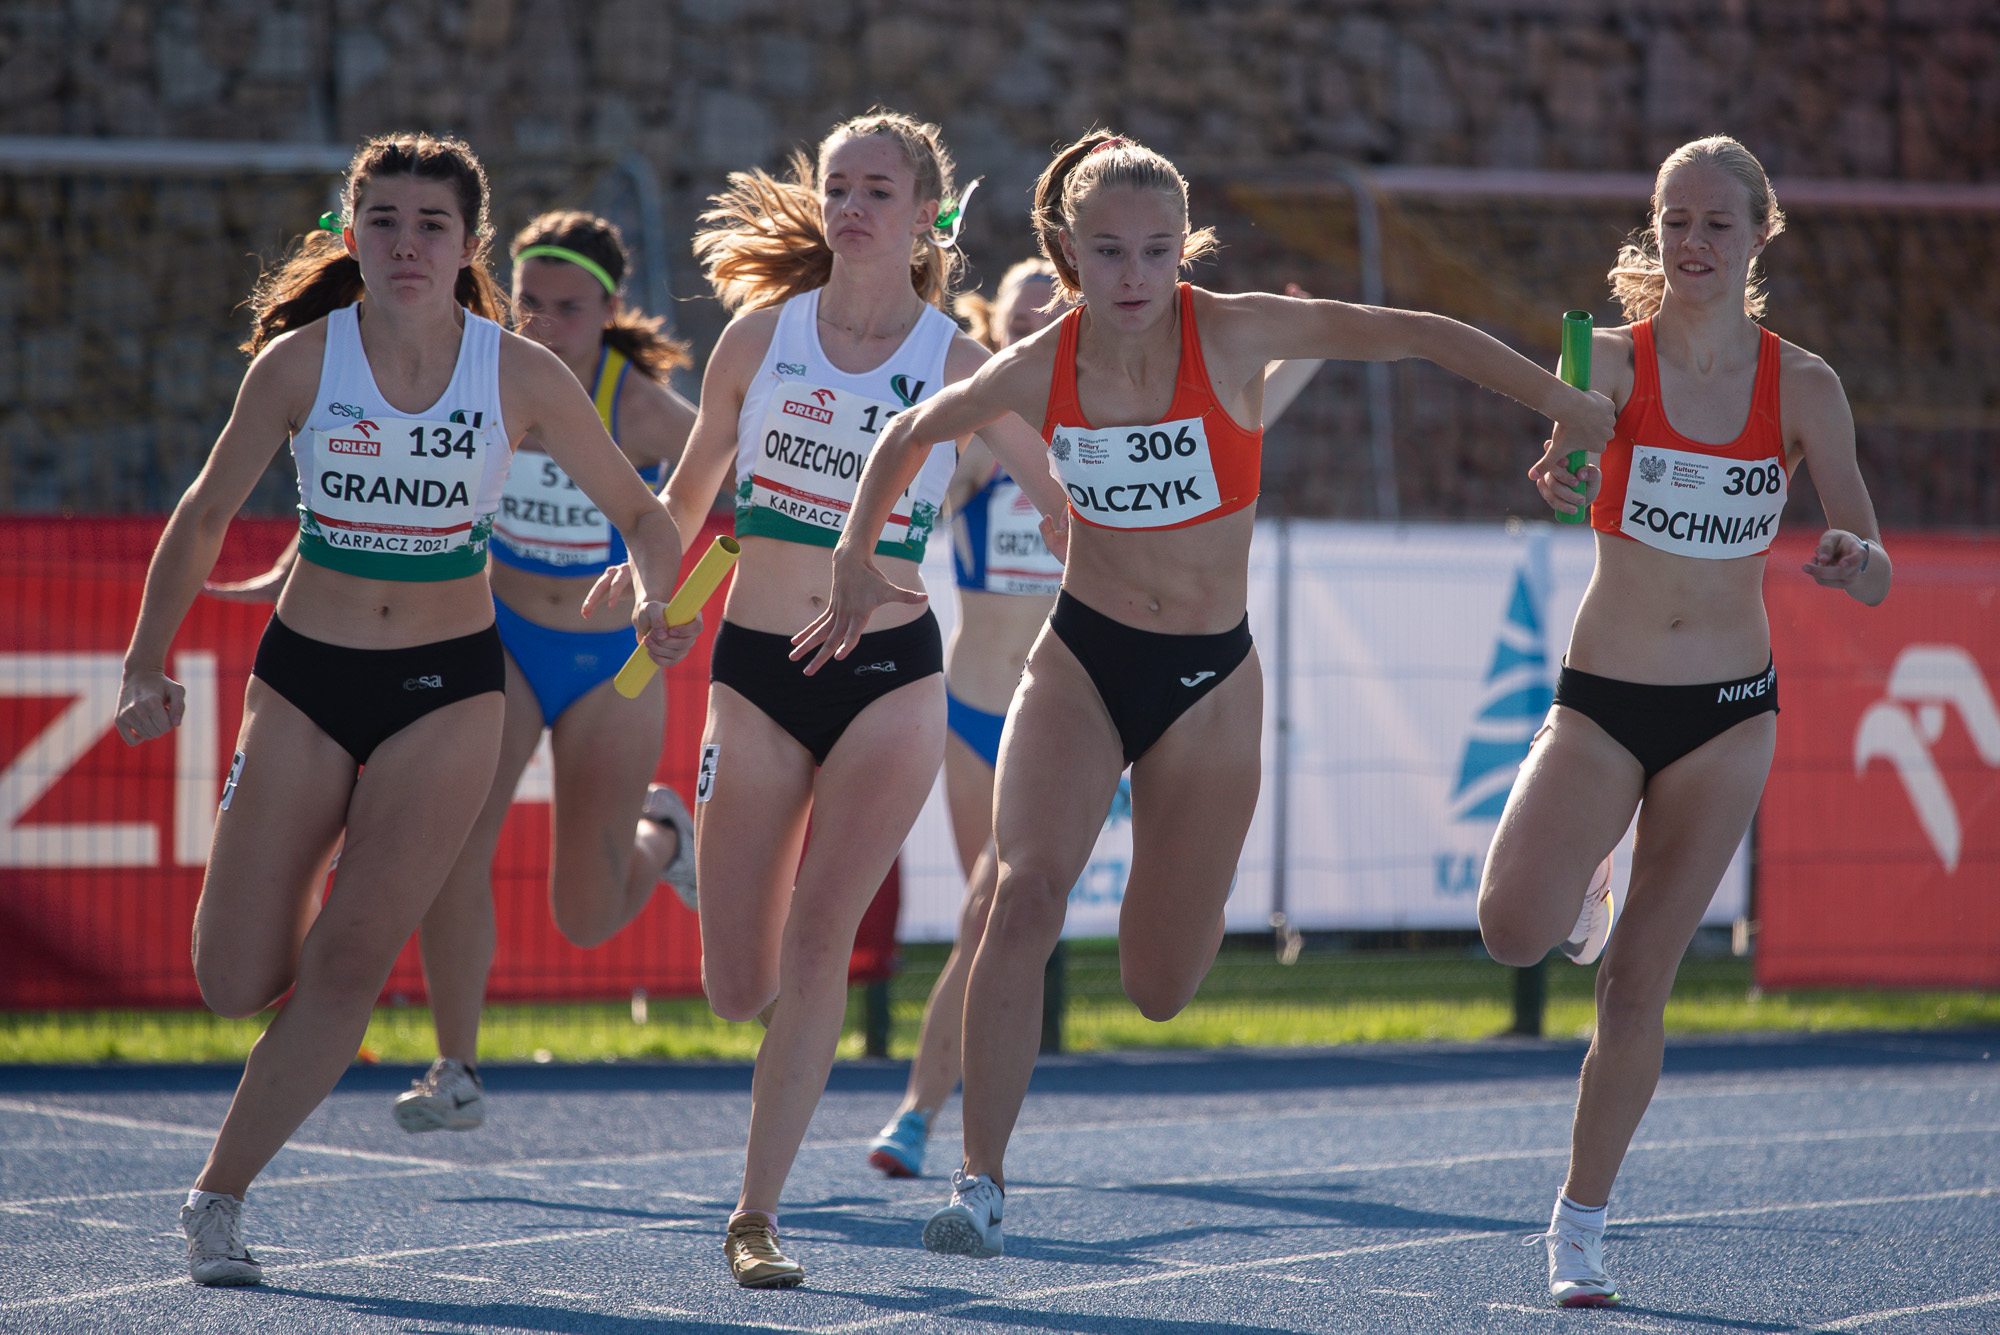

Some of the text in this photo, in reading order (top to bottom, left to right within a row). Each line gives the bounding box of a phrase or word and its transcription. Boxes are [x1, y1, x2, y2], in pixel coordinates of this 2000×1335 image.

[785, 402, 832, 424] ORLEN
[331, 440, 379, 455] ORLEN
[409, 426, 476, 459] 134
[1126, 425, 1197, 463] 306
[1673, 465, 1699, 475] Kultury
[1674, 460, 1709, 469] Ministerstwo
[1722, 463, 1781, 497] 308
[320, 470, 470, 508] GRANDA
[1066, 475, 1203, 513] OLCZYK
[501, 494, 602, 527] RZELEC
[769, 494, 842, 528] KARPACZ
[1628, 499, 1778, 545] ZOCHNIAK
[329, 530, 449, 553] KARPACZ 2021
[1717, 677, 1766, 704] NIKE
